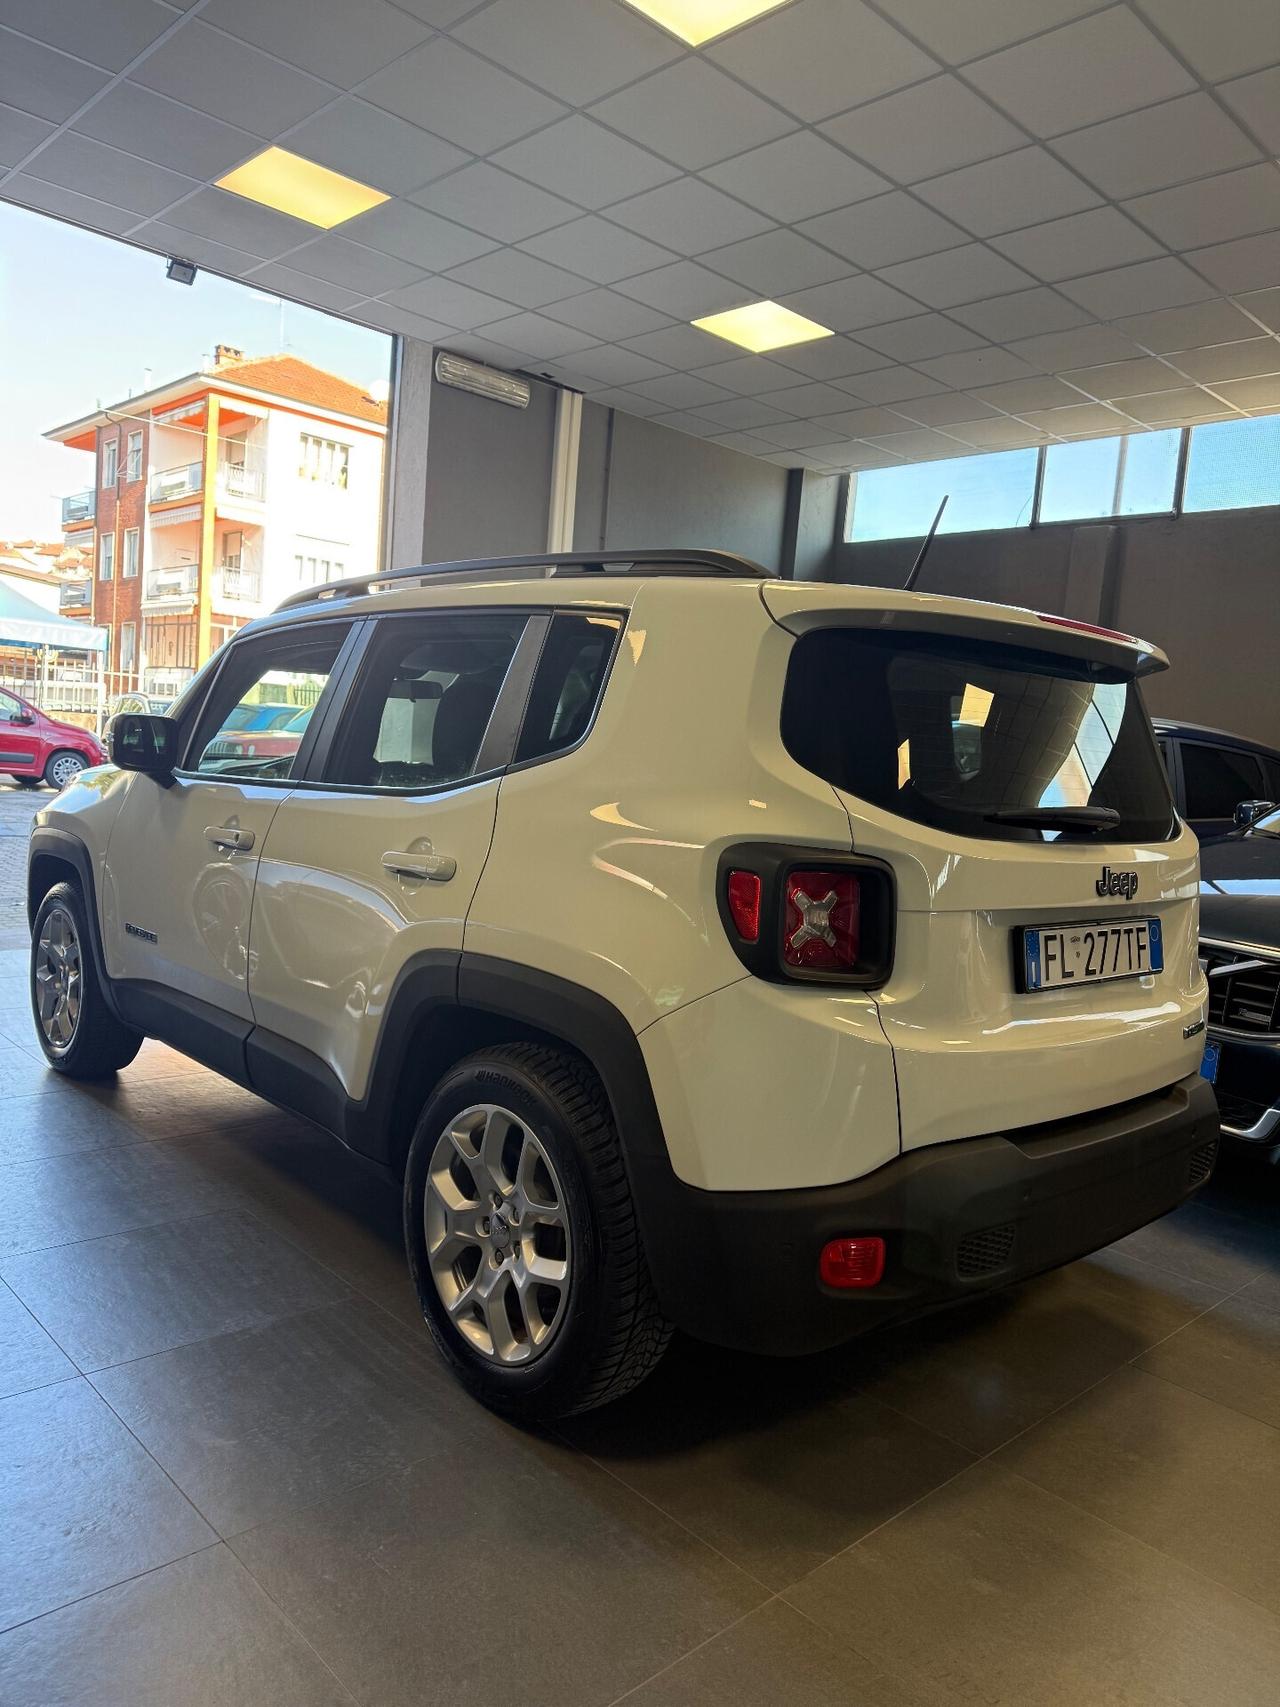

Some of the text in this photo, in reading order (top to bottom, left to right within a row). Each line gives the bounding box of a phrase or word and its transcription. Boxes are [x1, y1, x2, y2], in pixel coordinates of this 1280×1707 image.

[1096, 866, 1138, 899] Jeep
[1044, 926, 1147, 981] FL 277TF
